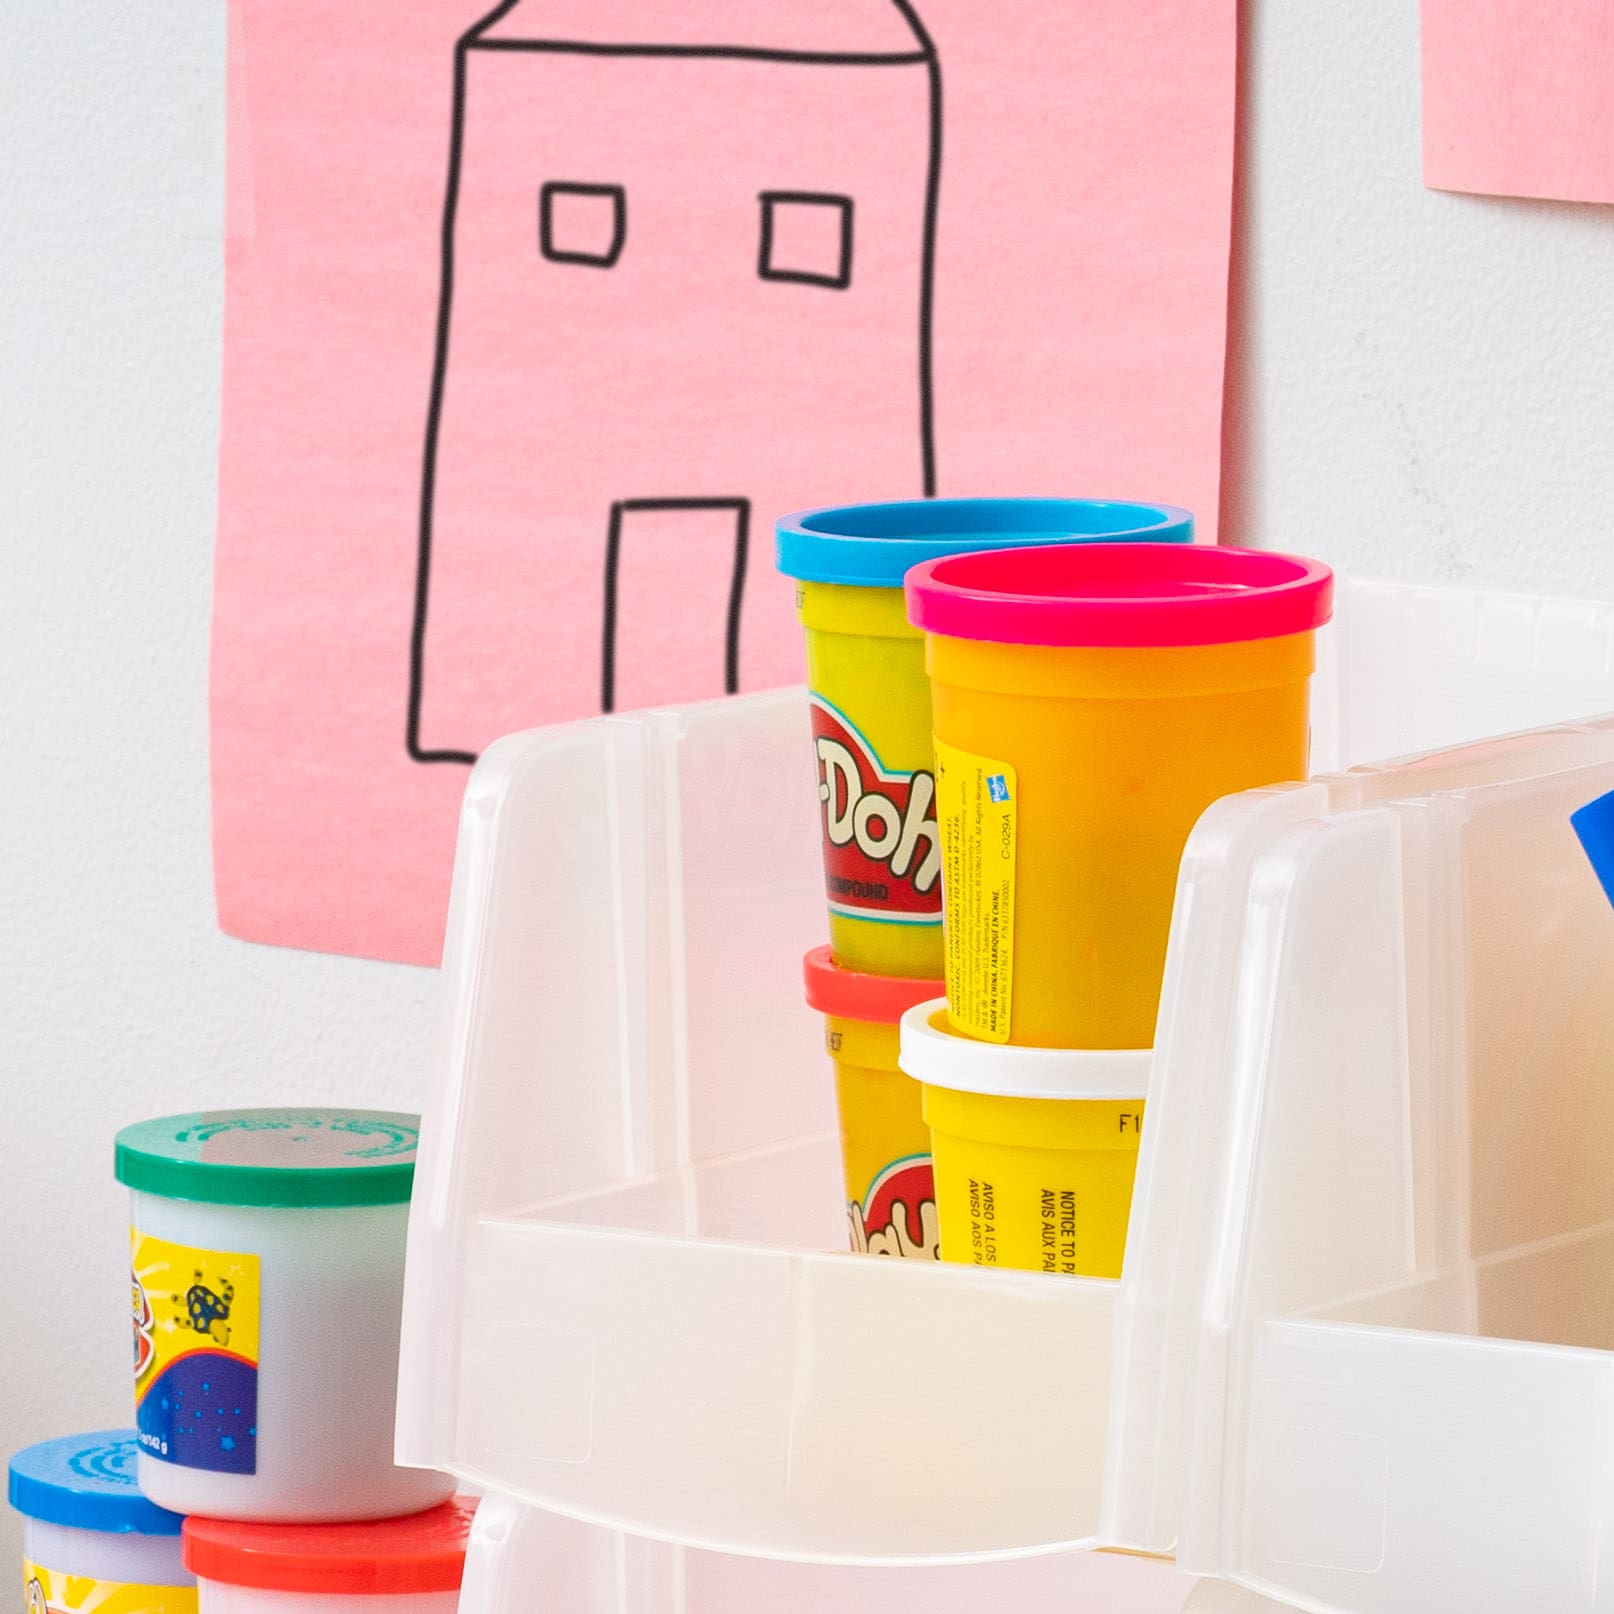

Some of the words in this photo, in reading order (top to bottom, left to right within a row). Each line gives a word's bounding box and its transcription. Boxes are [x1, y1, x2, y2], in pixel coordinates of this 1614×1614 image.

[1000, 814, 1011, 860] C-029A
[968, 1179, 981, 1218] AVISO
[982, 1182, 995, 1221] AVISO
[1041, 1189, 1055, 1218] AVIS
[1060, 1191, 1075, 1237] NOTICE
[971, 1221, 982, 1248] AOS
[1042, 1221, 1055, 1248] AUX
[984, 1237, 996, 1262] LOS
[1061, 1241, 1075, 1258] TO
